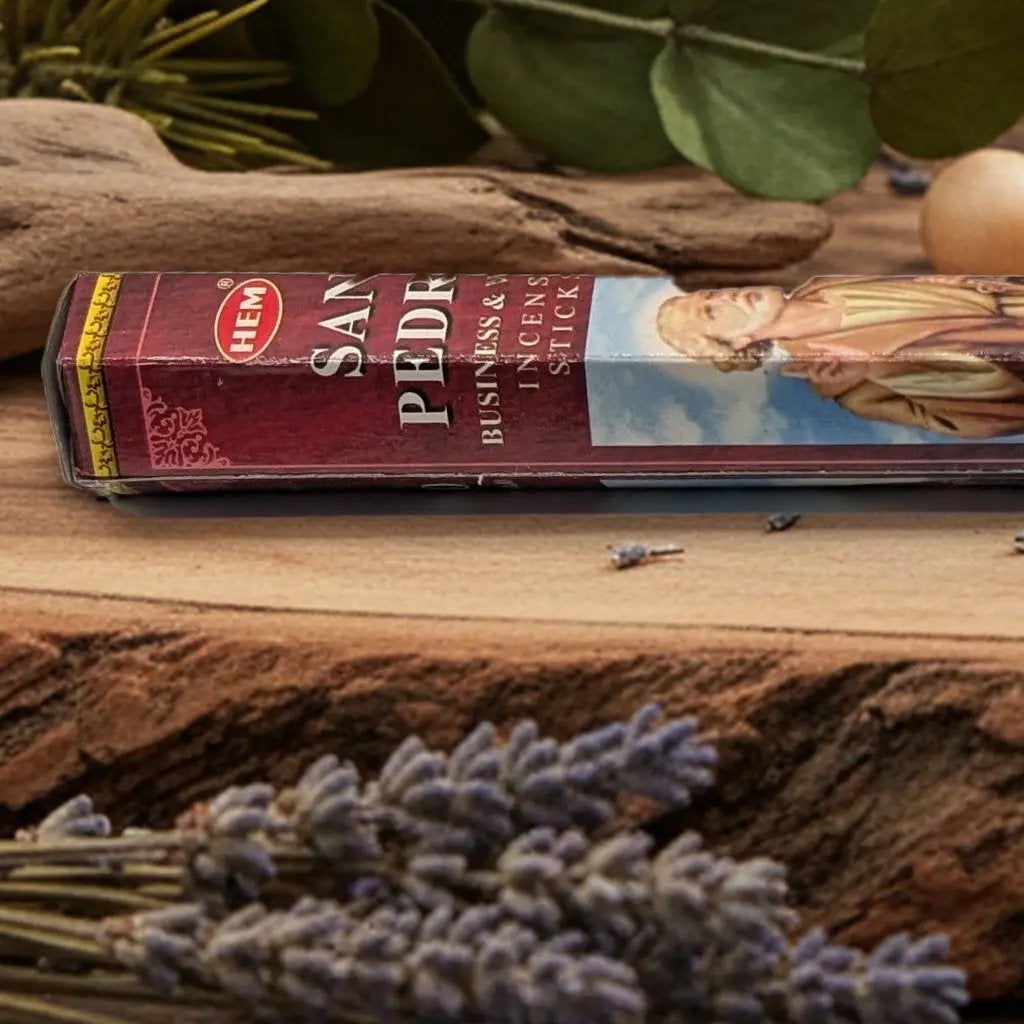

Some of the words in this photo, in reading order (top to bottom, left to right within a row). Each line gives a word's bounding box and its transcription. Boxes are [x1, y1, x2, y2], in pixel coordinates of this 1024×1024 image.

[230, 285, 267, 352] HEM
[310, 273, 375, 376] SAN
[482, 292, 505, 309] &
[549, 275, 580, 374] STICK
[474, 314, 505, 444] BUSINESS
